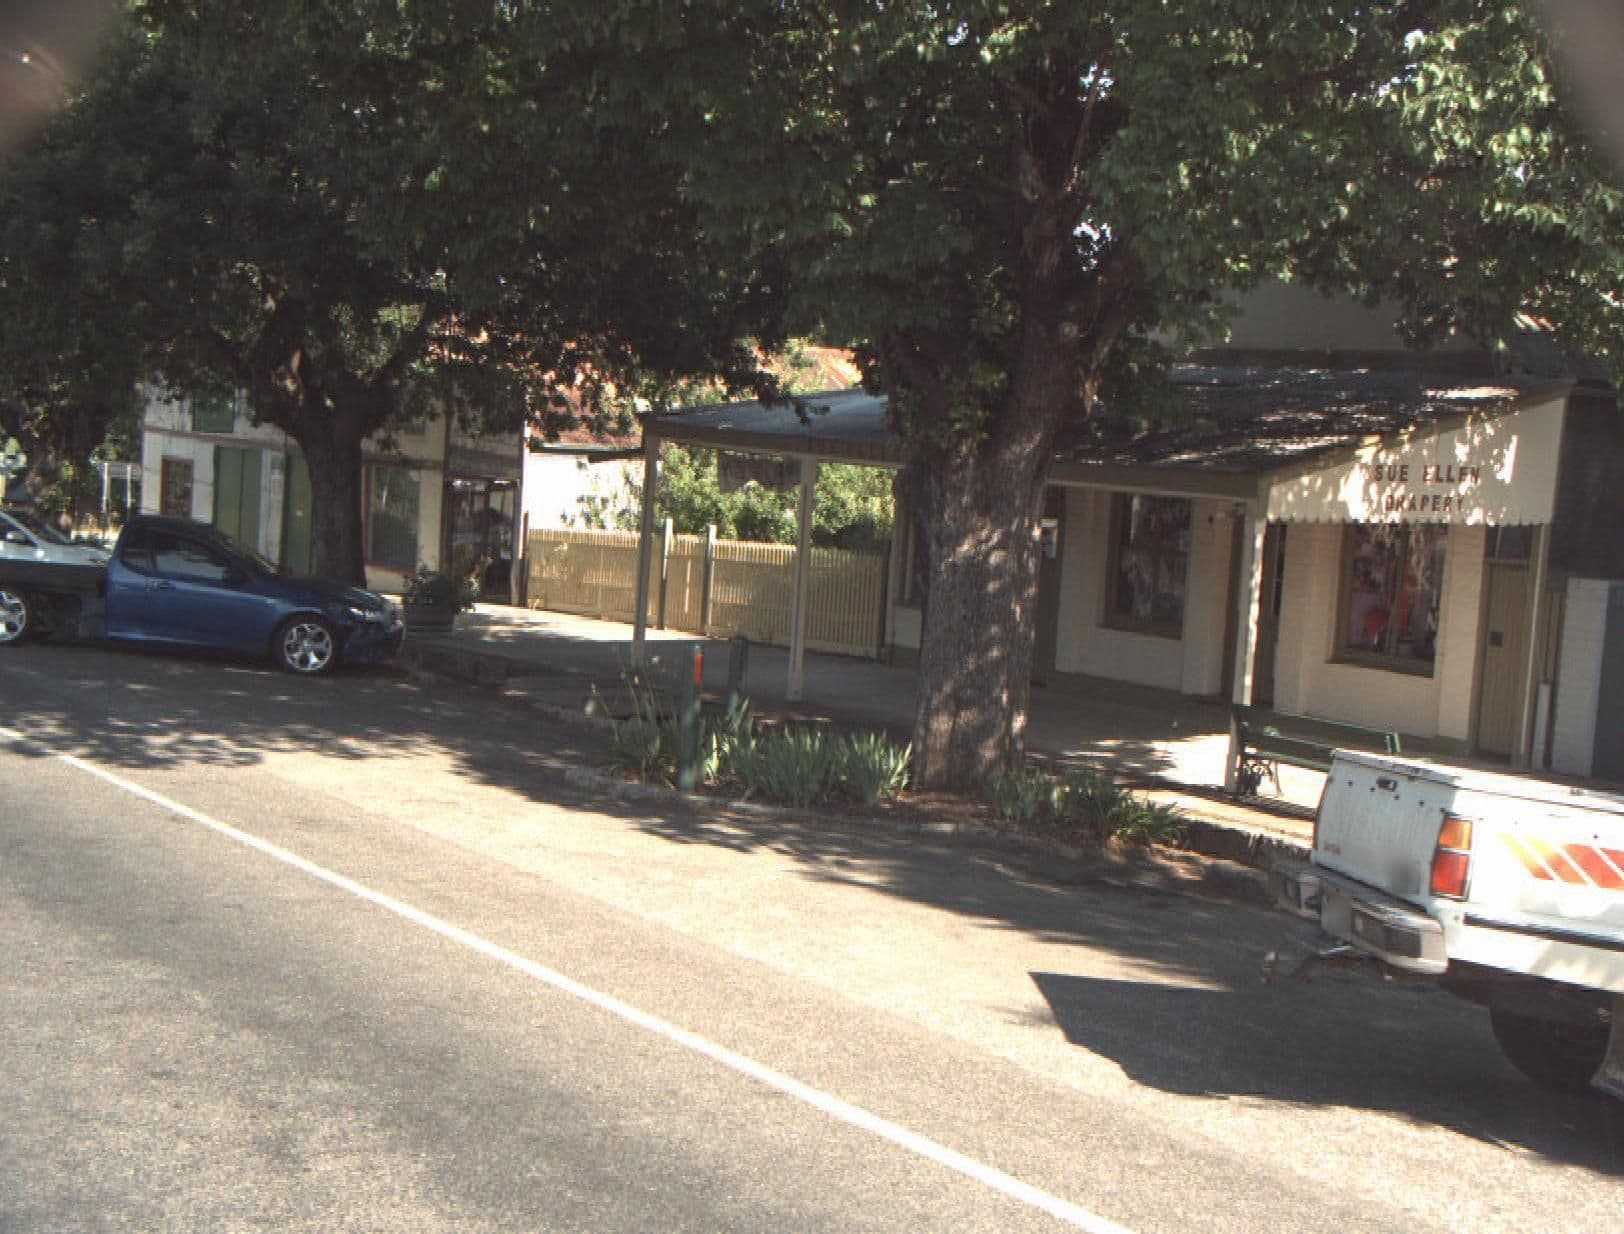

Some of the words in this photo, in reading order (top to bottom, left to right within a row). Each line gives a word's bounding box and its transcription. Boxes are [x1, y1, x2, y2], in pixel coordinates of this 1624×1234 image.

[1375, 464, 1408, 481] SUE
[1423, 465, 1480, 483] ELLEN
[1385, 494, 1465, 511] DRAPERY
